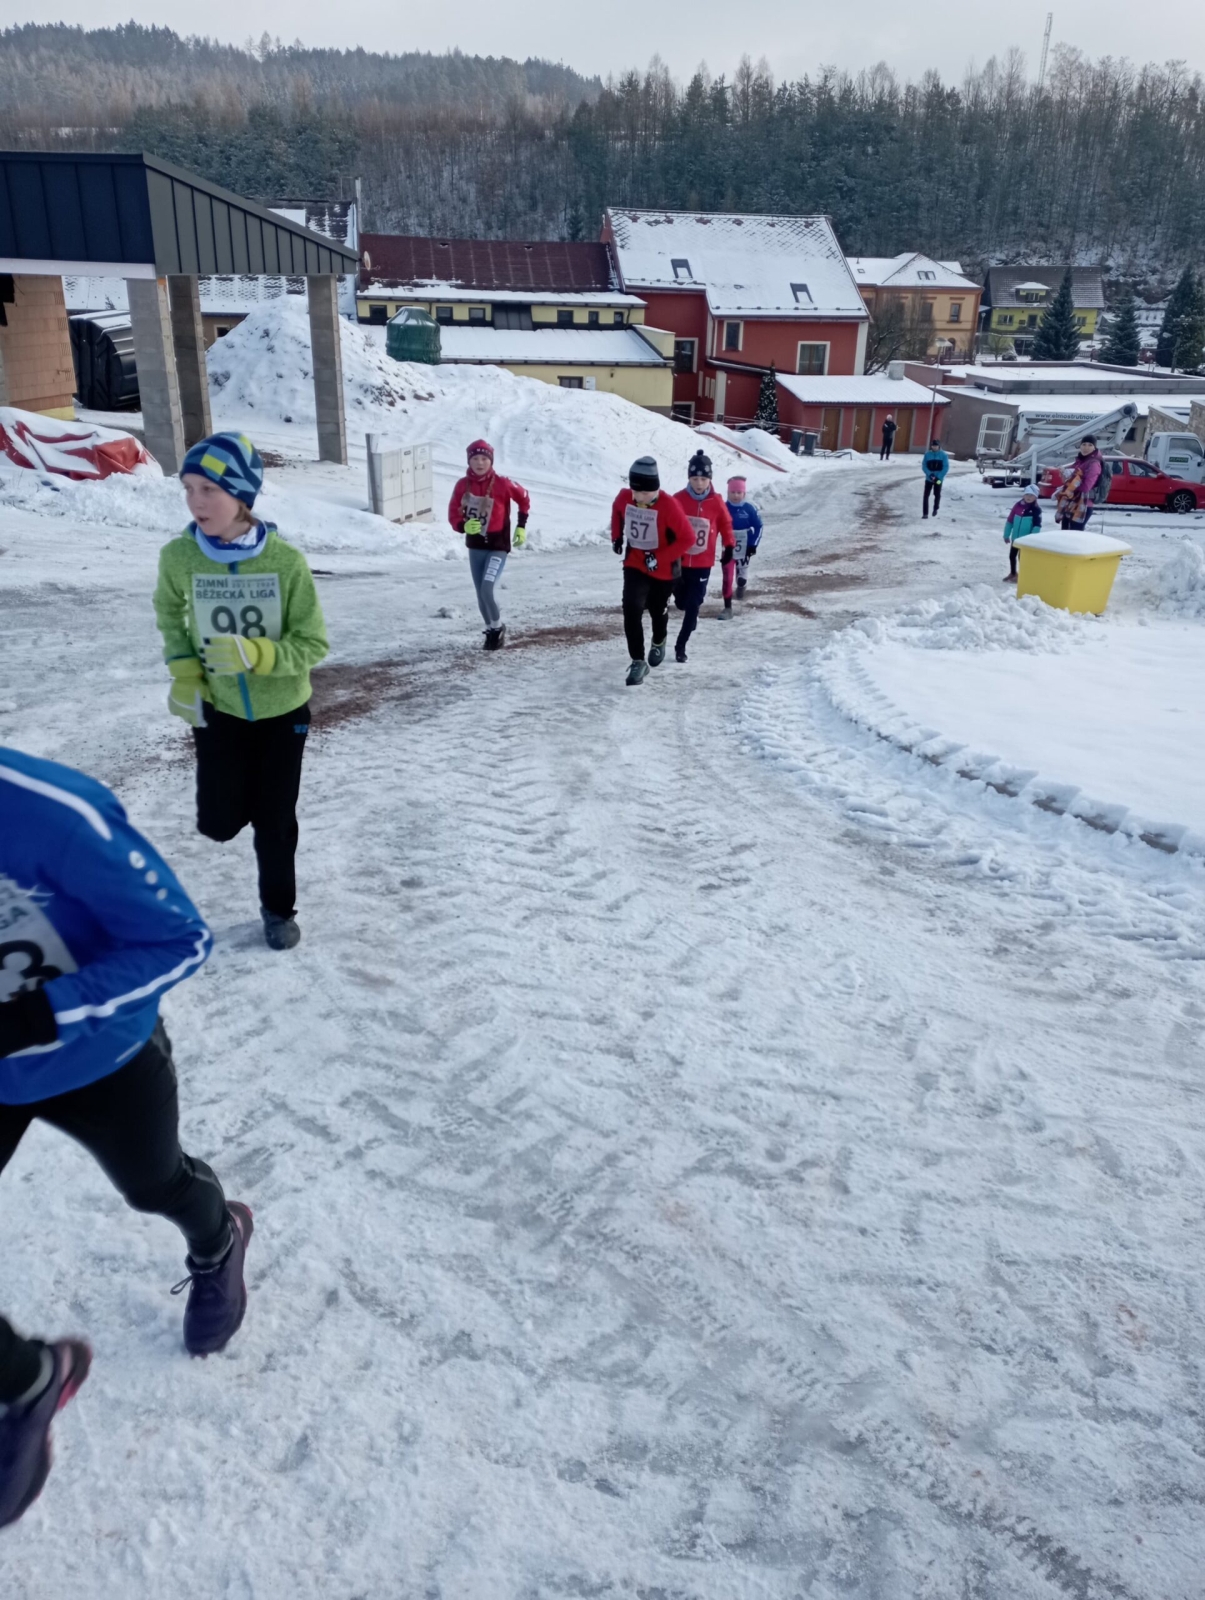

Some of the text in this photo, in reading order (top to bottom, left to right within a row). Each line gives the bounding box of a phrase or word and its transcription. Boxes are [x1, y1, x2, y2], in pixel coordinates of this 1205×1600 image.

[630, 520, 650, 540] 57
[195, 577, 228, 588] ZIMNÍ
[195, 589, 276, 599] BĚŽECKÁ LIGA
[211, 605, 266, 640] 98
